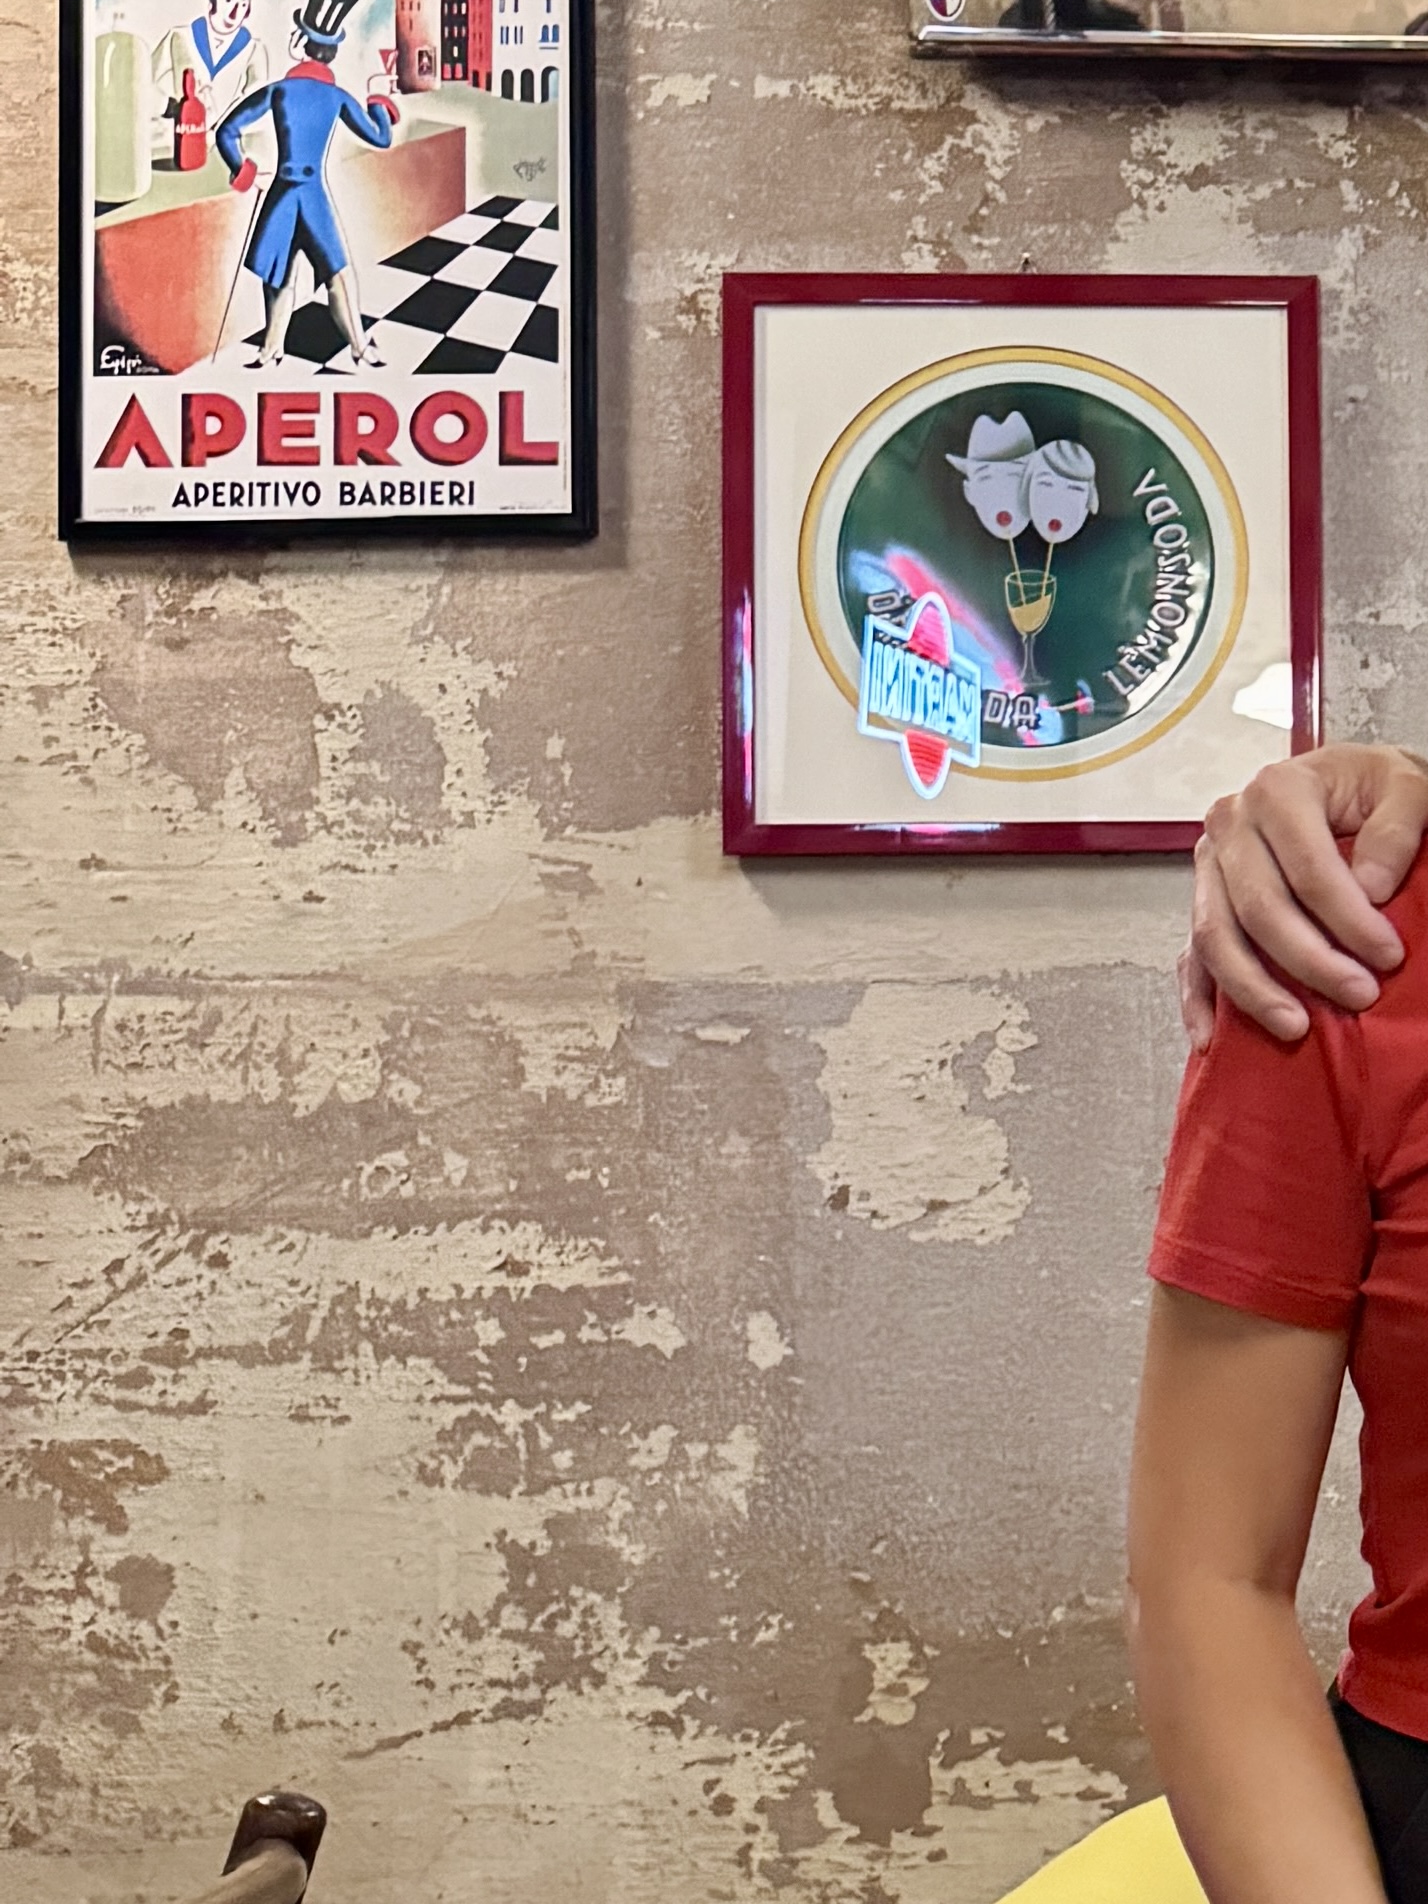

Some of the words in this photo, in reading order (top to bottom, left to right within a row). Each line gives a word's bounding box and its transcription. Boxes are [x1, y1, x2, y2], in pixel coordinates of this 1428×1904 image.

[94, 390, 559, 468] APEROL
[172, 481, 321, 508] APERITIVO
[341, 480, 476, 506] BARBIERI
